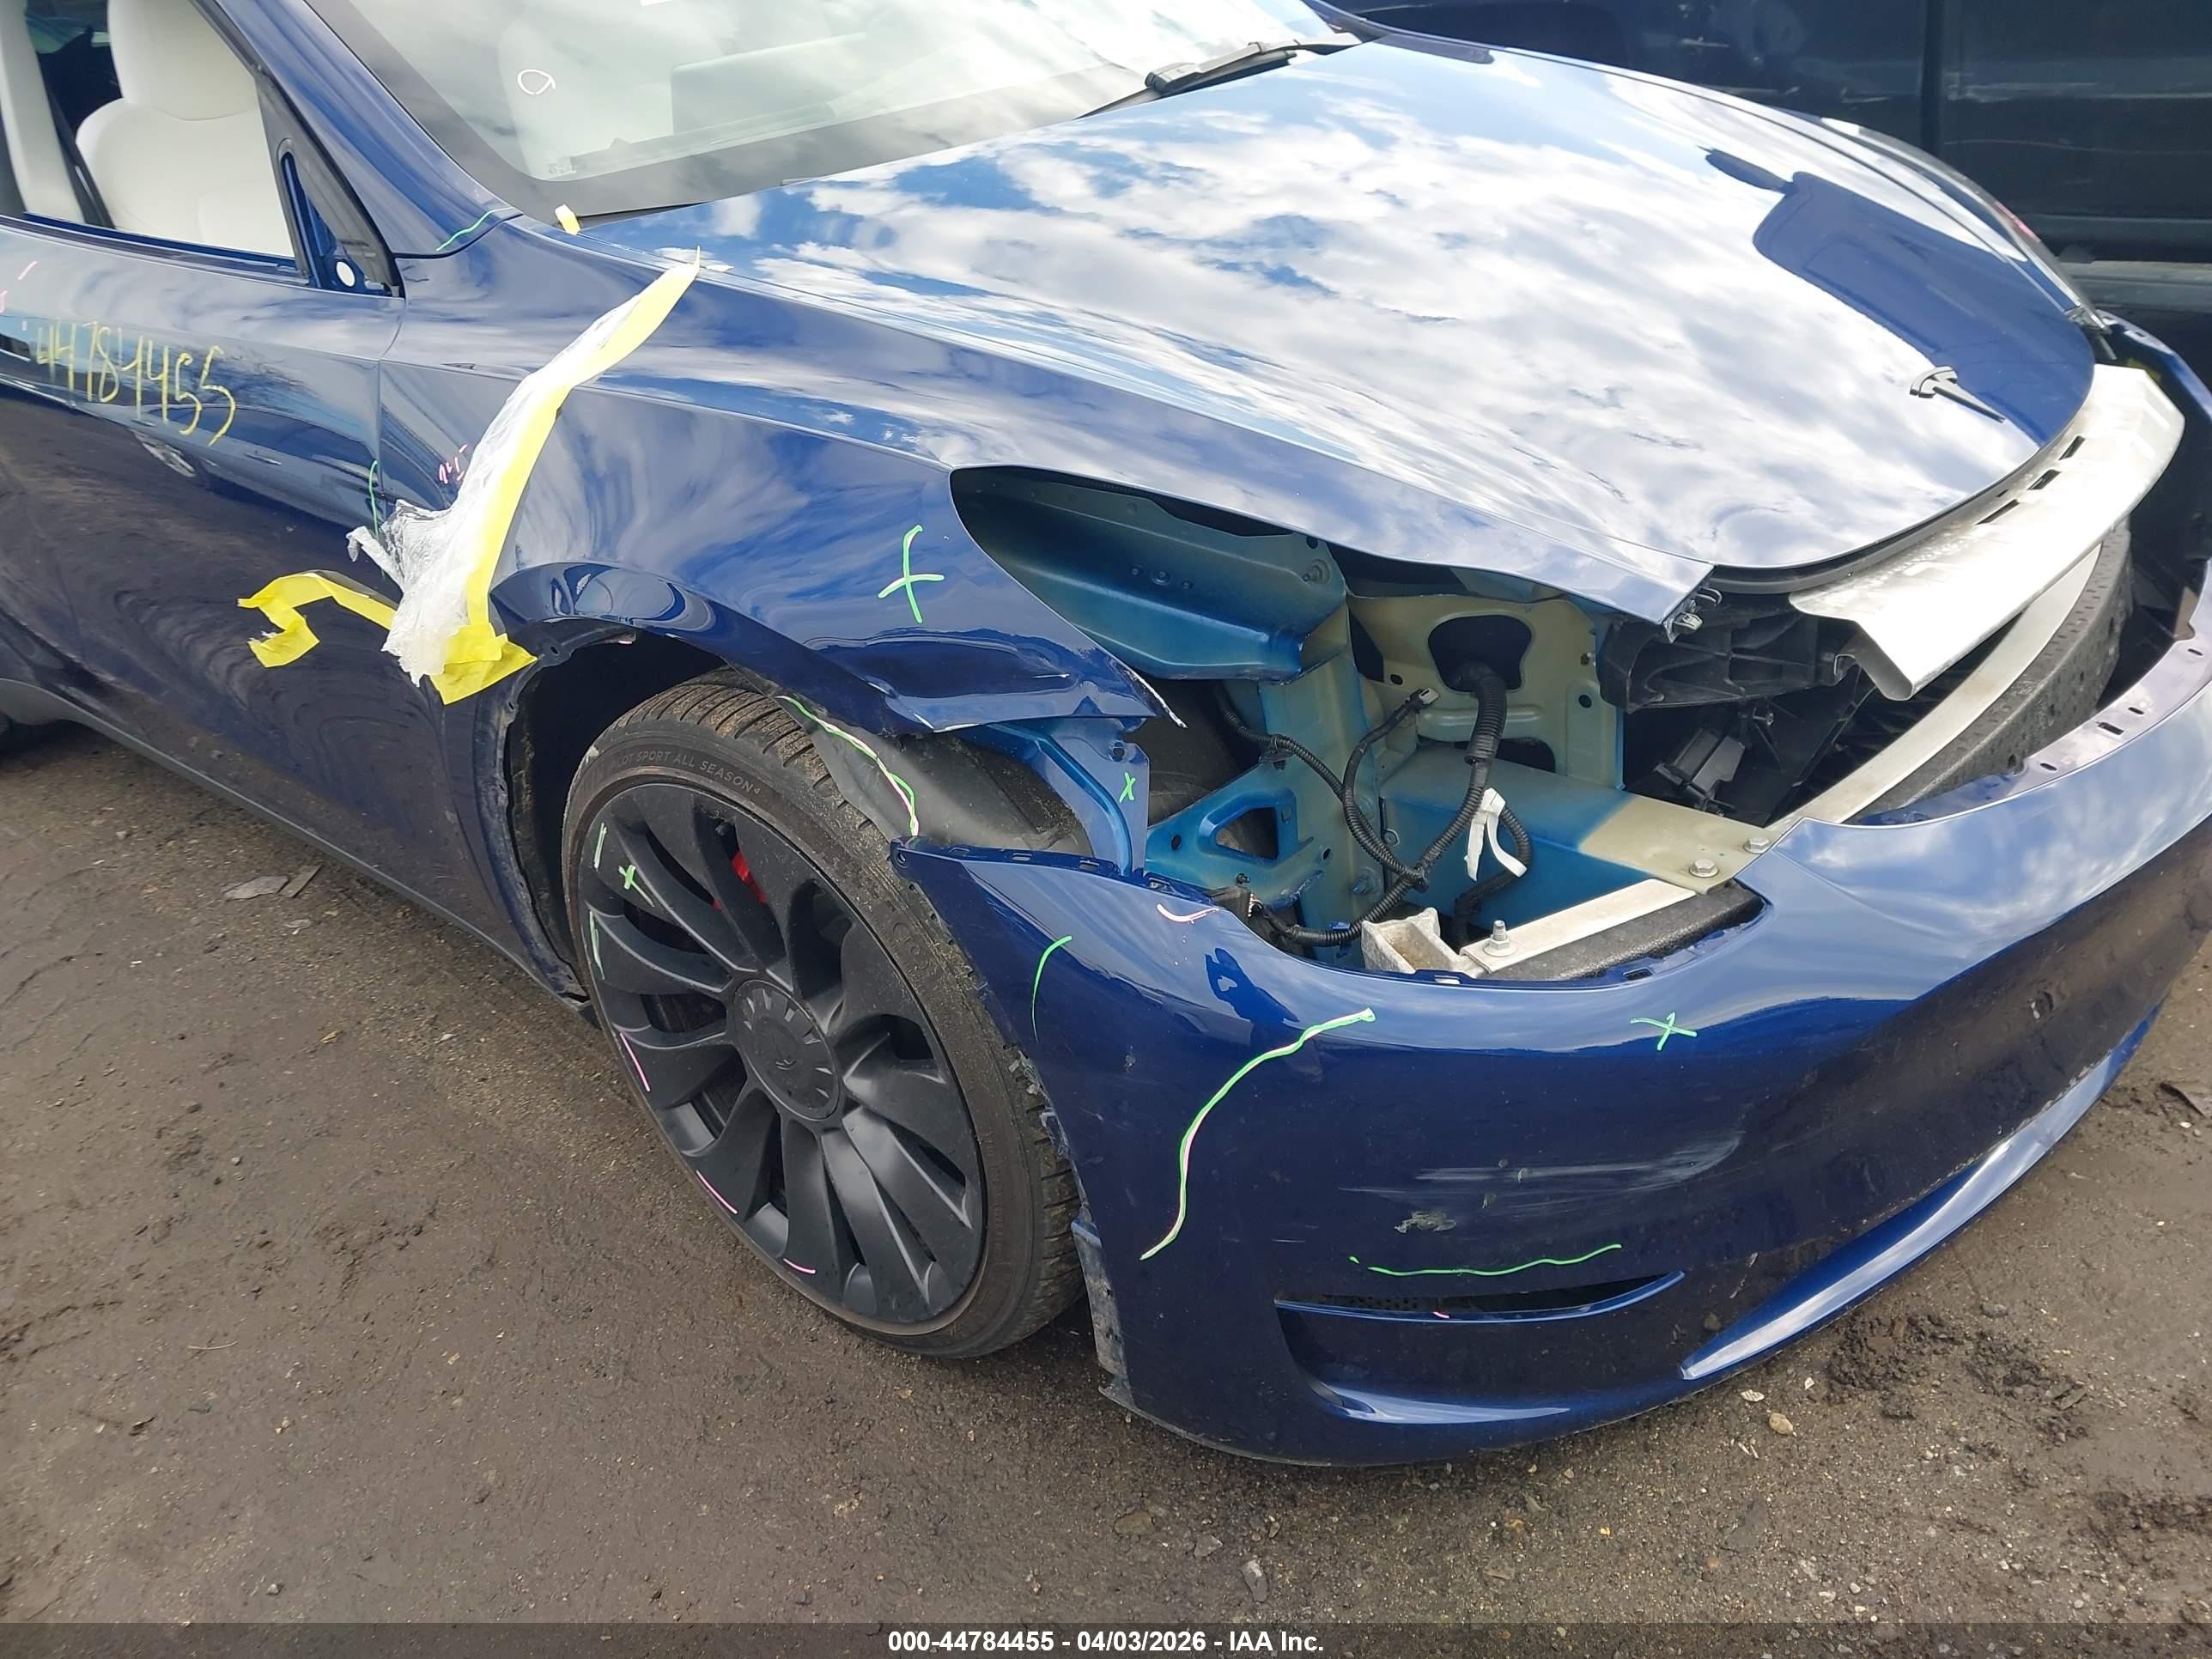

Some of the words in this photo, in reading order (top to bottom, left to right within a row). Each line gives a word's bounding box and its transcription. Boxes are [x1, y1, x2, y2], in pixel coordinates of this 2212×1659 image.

[637, 750, 672, 762] SPORT
[673, 752, 695, 768] ALL
[700, 760, 754, 793] SEASON
